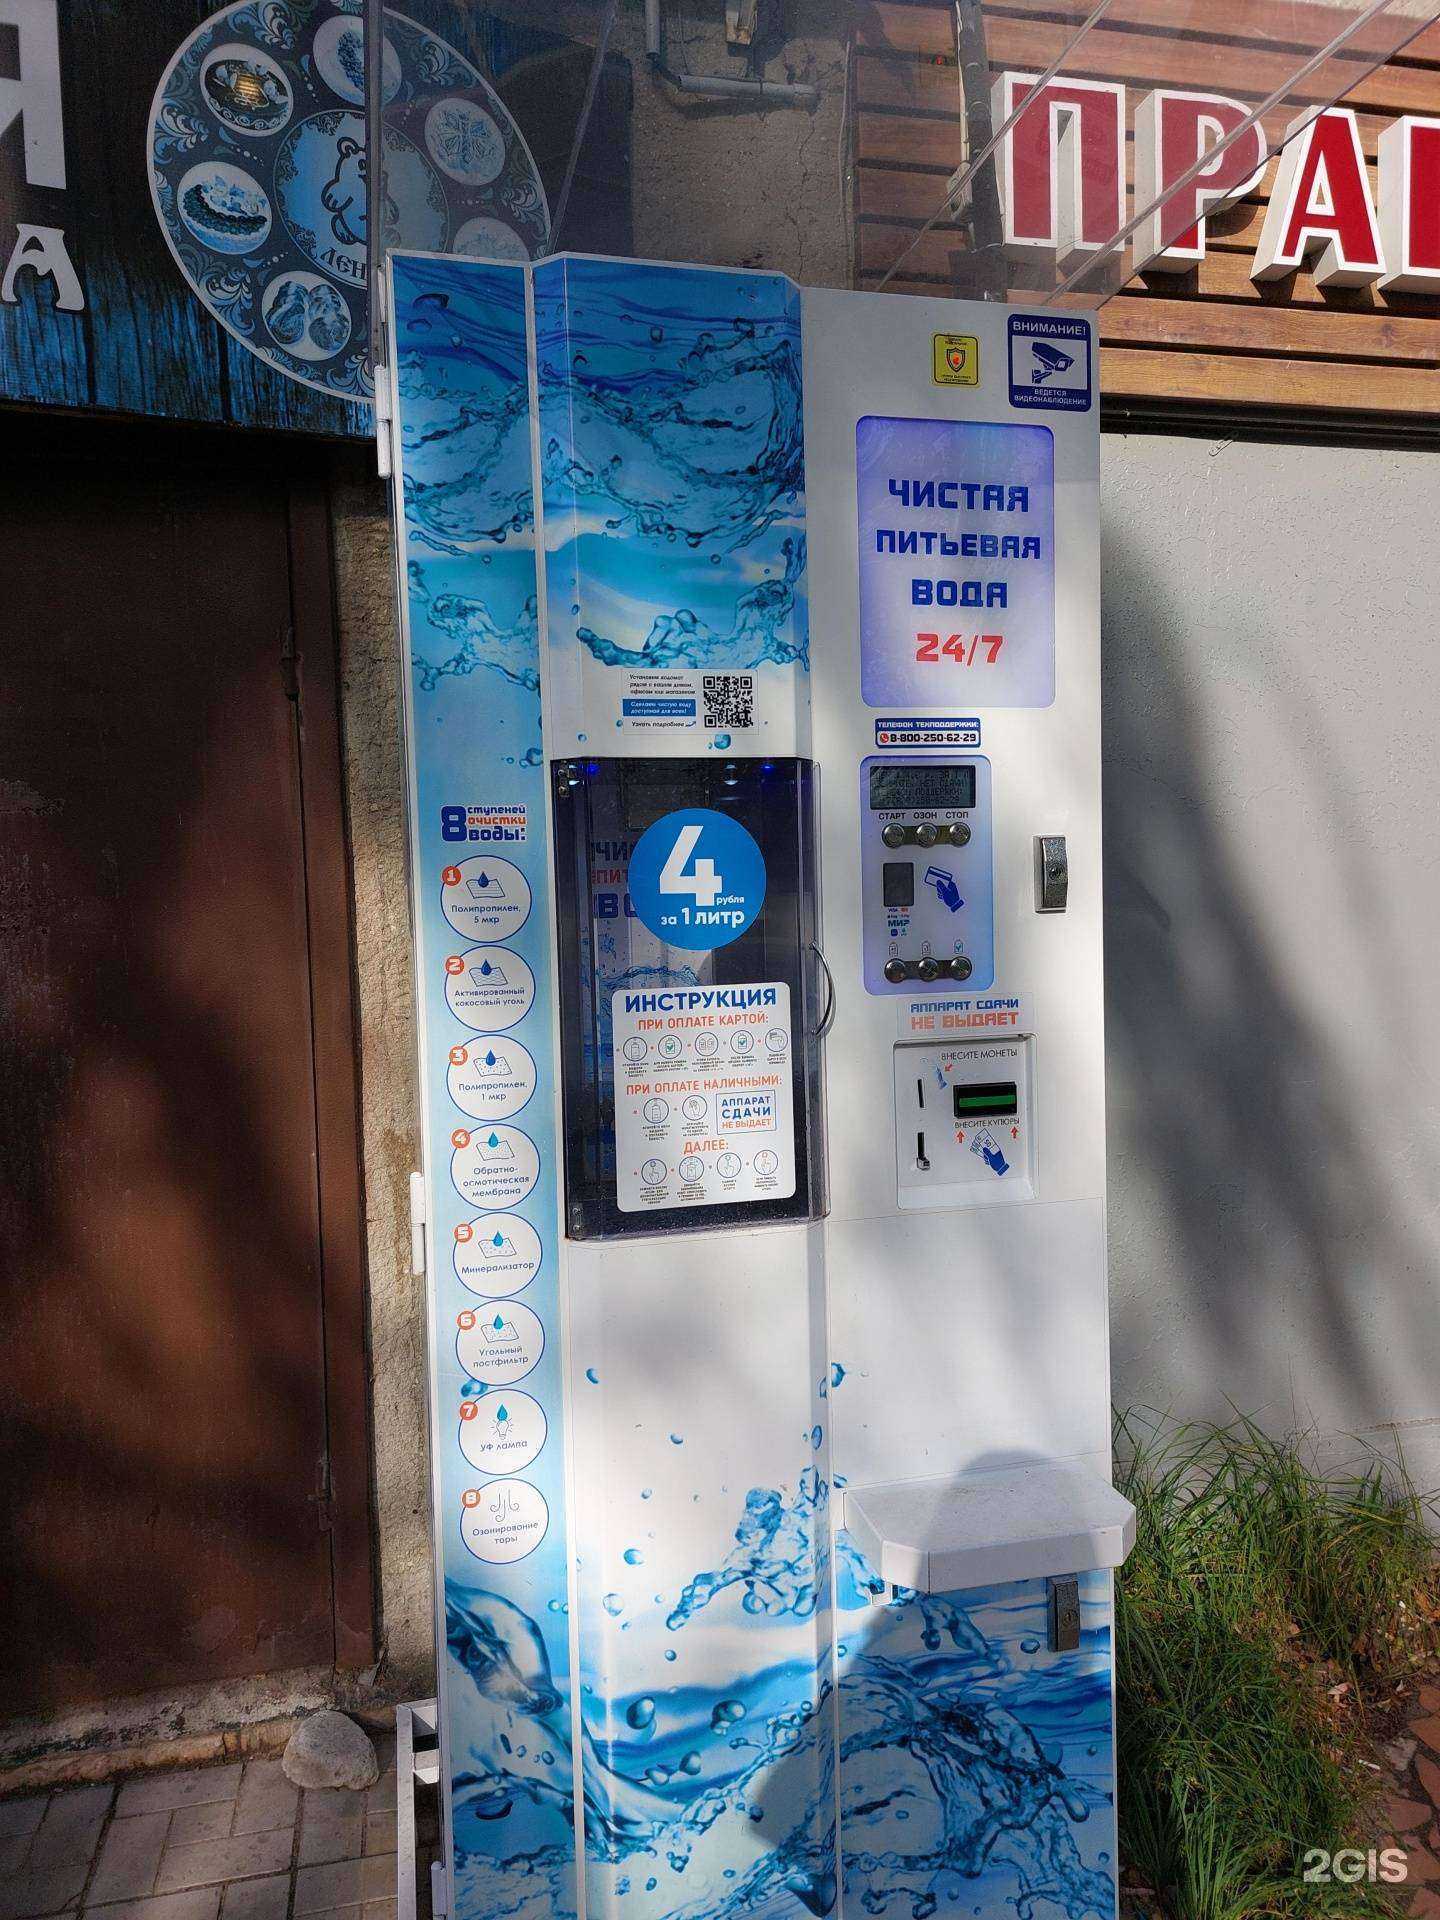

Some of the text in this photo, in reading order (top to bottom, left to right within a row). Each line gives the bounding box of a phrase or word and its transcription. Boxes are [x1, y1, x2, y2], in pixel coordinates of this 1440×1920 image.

[1012, 321, 1086, 336] ВНИМАНИЕ!
[1034, 388, 1067, 397] ВЕДЕТСЯ
[1014, 394, 1087, 405] ВИДЕОНАБЛЮДЕНИЕ
[888, 478, 1029, 512] ЧИСТАЯ
[876, 529, 1040, 559] ПИТЬЕВАЯ
[911, 579, 1008, 608] ВОДА
[916, 633, 1003, 666] 24/7
[890, 733, 977, 743] 8-800-250-62-29
[468, 815, 527, 825] очистки
[878, 811, 969, 821] СТАРТ ОЗОН СТОП
[441, 805, 526, 842] 8 ступеней
[468, 826, 526, 841] воды:
[659, 825, 723, 907] 4
[446, 869, 456, 882] 1
[716, 895, 745, 906] рубля
[451, 904, 521, 914] Полипропилен,
[474, 916, 500, 925] 5 мкр
[661, 908, 745, 928] за 1 литр
[888, 919, 910, 928] МИР
[449, 959, 461, 971] 2
[454, 987, 525, 997] Активированный
[455, 997, 525, 1007] кокосовый уголь
[625, 987, 777, 1013] ИНСТРУКЦИЯ
[911, 998, 1019, 1013] АППАРАТ СДАЧИ
[638, 1011, 769, 1032] ПРИ ОПЛАТЕ КАРТОЙ:
[911, 1012, 1019, 1030] НЕ ВЫДАЕТ
[452, 1050, 464, 1062] 3
[941, 1048, 1018, 1062] ВНЕСИТЕ МОНЕТЫ
[459, 1081, 528, 1092] Полипропилен,
[626, 1074, 783, 1096] ПРИ ОПЛАТЕ НАЛИЧНЫМИ:
[488, 1093, 507, 1102] мкр
[721, 1096, 771, 1108] АППАРАТ
[721, 1106, 771, 1120] СДАЧИ
[722, 1118, 771, 1129] НЕ ВЫДАЕТ
[954, 1118, 1020, 1129] ВНЕСИТЕ КУПЮРЫ
[454, 1132, 467, 1144] 4
[683, 1139, 729, 1155] ДАЛЕЕ:
[473, 1166, 518, 1175] Обратно-
[463, 1176, 530, 1187] осмотическая
[472, 1187, 521, 1197] мембрана
[457, 1227, 470, 1239] 5
[461, 1262, 535, 1274] Минерализатор
[478, 1346, 523, 1357] Угольный
[473, 1356, 529, 1368] постфильтр
[463, 1404, 475, 1418] 7
[497, 1440, 528, 1450] лампа
[472, 1522, 539, 1536] Озонирование
[494, 1536, 518, 1546] тары
